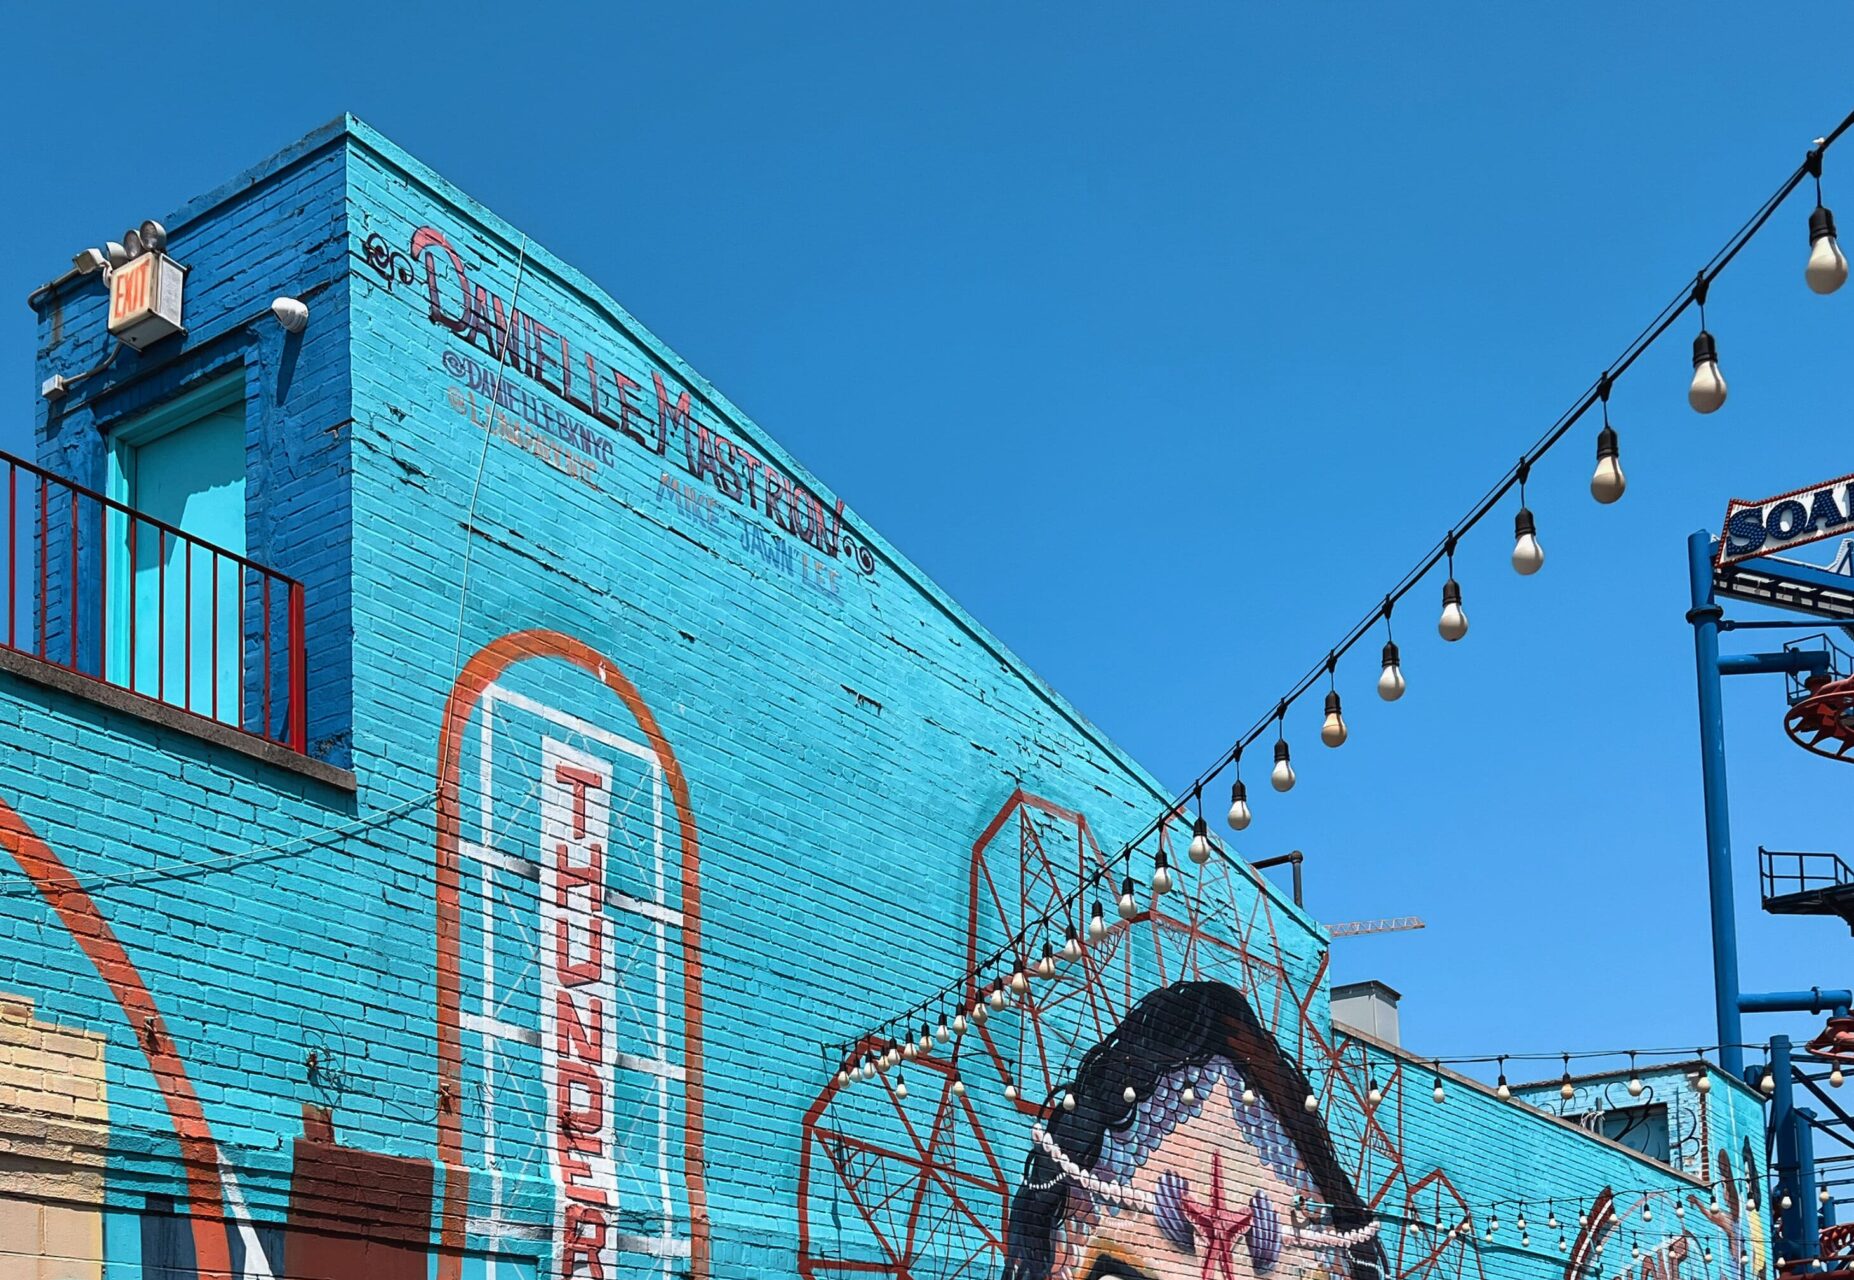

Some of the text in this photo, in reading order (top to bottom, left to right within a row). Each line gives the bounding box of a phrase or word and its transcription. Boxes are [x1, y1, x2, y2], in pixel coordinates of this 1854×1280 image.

[114, 258, 150, 318] EXIT
[410, 226, 845, 560] DANIELLE MASTRION
[1726, 481, 1854, 557] SOA
